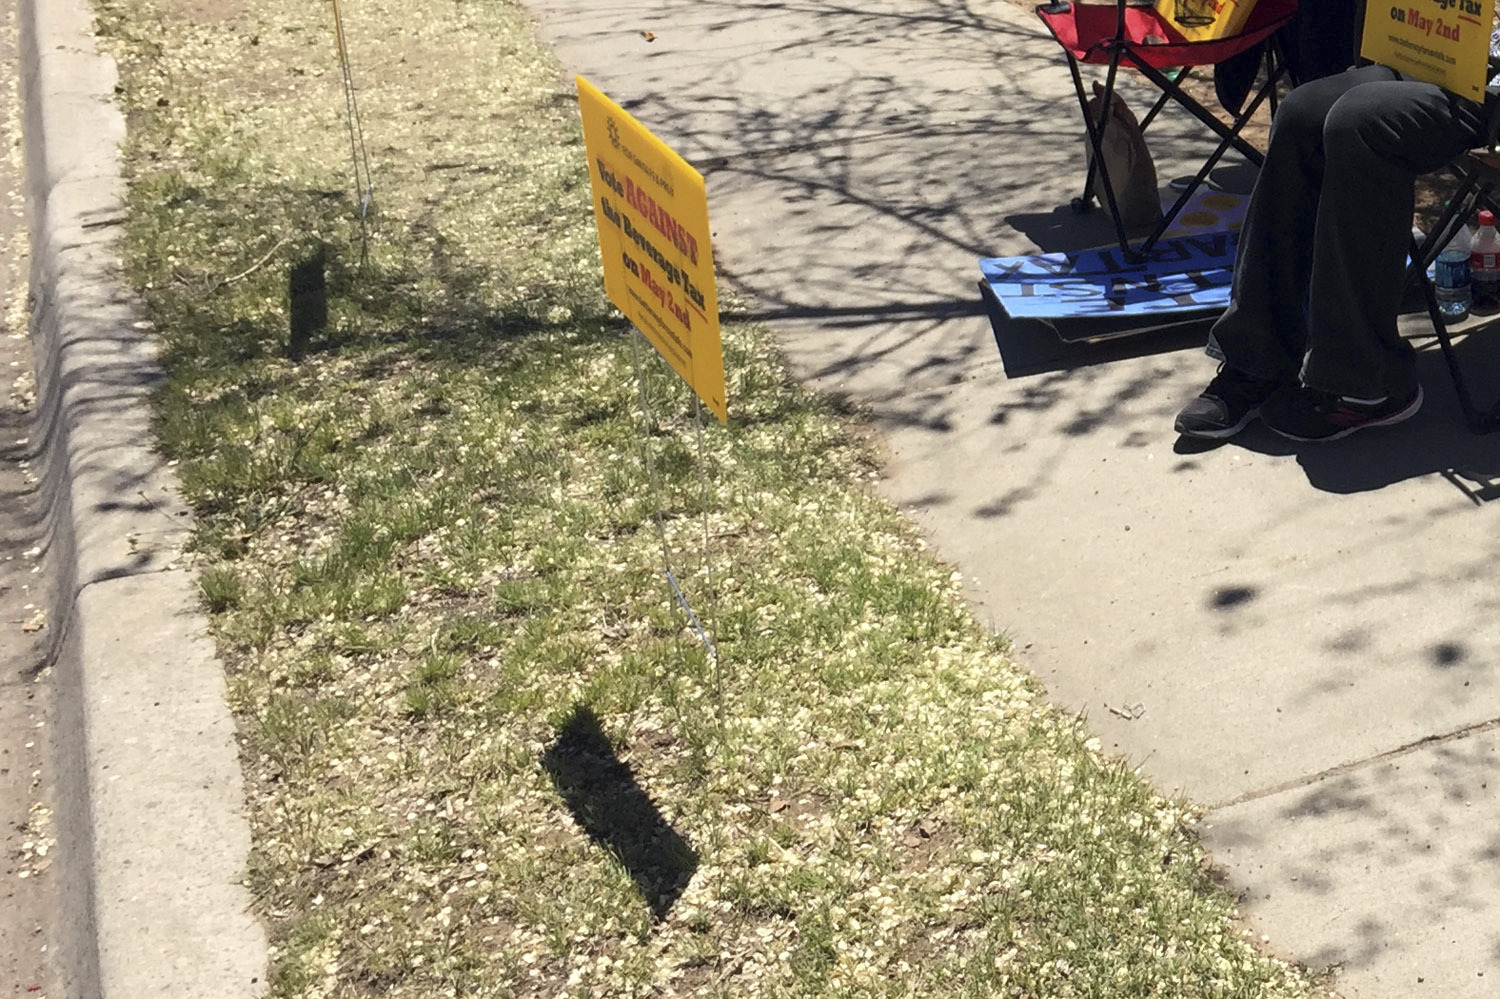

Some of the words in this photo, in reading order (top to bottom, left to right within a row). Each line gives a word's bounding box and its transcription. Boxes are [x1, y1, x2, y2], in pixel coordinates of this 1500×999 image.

[1390, 6, 1405, 22] on
[1408, 8, 1433, 37] May
[1435, 17, 1460, 42] 2nd
[596, 158, 624, 198] Vote
[625, 175, 698, 268] AGAINST
[601, 196, 621, 229] the
[622, 213, 681, 286] Beverage
[681, 268, 706, 312] Tax
[622, 251, 639, 279] on
[639, 262, 665, 308] May
[667, 290, 691, 332] 2nd
